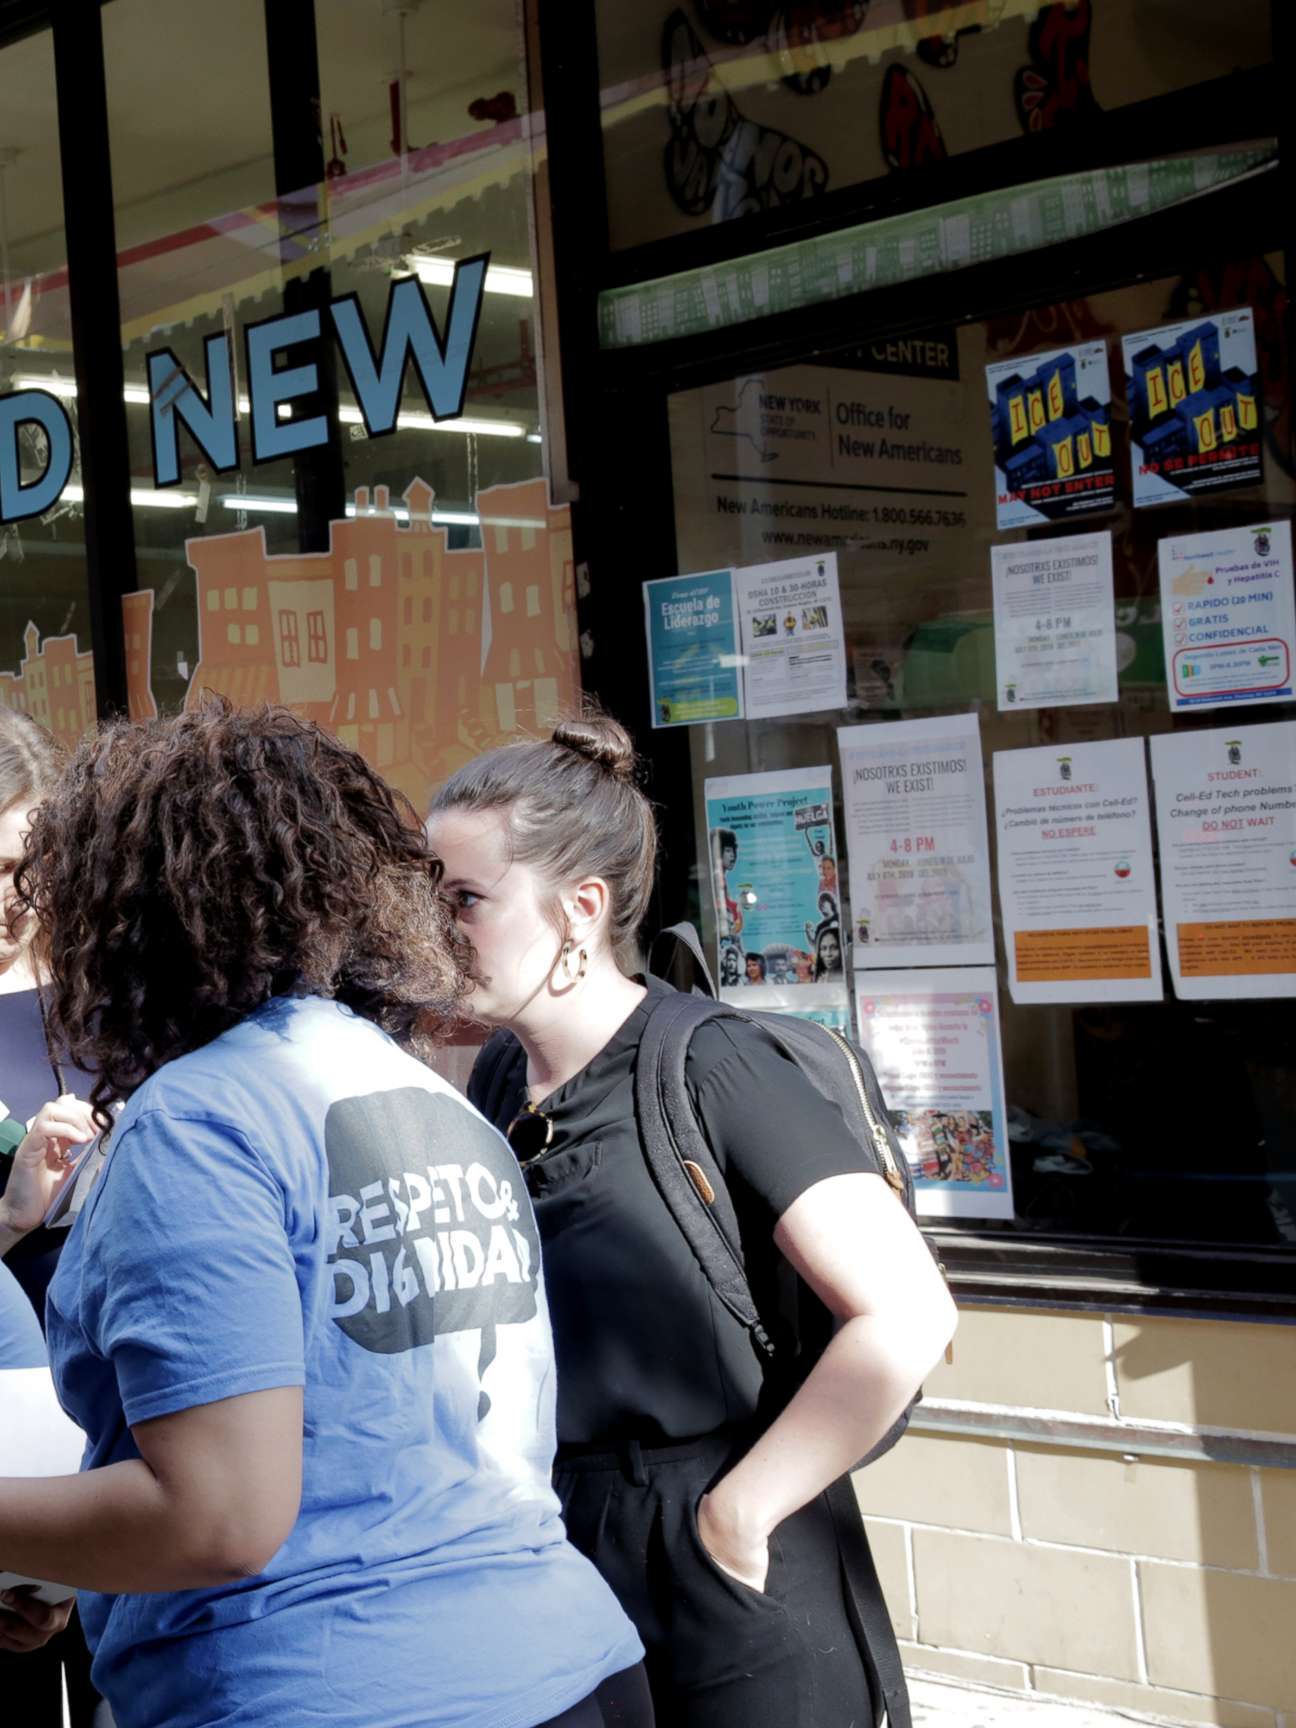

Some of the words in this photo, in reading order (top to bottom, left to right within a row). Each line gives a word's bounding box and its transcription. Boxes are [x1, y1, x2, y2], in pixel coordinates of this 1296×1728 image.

[871, 339, 950, 368] CENTER
[146, 251, 492, 488] NEW
[1149, 353, 1201, 407] ICE
[760, 394, 785, 411] NEW
[788, 398, 822, 415] YORK
[1011, 382, 1063, 433] ICE
[836, 403, 884, 427] Office
[888, 406, 911, 430] for
[1199, 400, 1254, 448] OUT
[838, 435, 874, 458] New
[878, 439, 963, 465] Americans
[1058, 427, 1106, 473] OUT
[1139, 462, 1161, 475] NO
[1164, 456, 1185, 471] SE
[1030, 480, 1062, 499] NOT
[1065, 474, 1116, 494] ENTER
[717, 497, 746, 514] New
[750, 499, 817, 519] Americans
[820, 503, 867, 522] Hotline:
[1264, 559, 1281, 568] VIH
[661, 598, 704, 617] Escuela
[706, 595, 721, 609] de
[1188, 614, 1229, 627] GRATIS
[1188, 625, 1269, 642] CONFIDENCIAL
[911, 758, 967, 778] EXISTIMOS!
[886, 781, 902, 795] WE
[904, 777, 935, 793] EXIST!
[1176, 790, 1213, 802] Cell-Ed
[1215, 788, 1241, 799] Tech
[1243, 784, 1293, 797] problems
[721, 800, 747, 813] Youth
[1170, 808, 1208, 819] Change
[1211, 804, 1222, 814] of
[1224, 803, 1257, 815] phone
[1202, 820, 1218, 832] DO
[1221, 818, 1244, 831] NOT
[1247, 815, 1275, 827] WAIT
[890, 838, 913, 853] 4-8
[916, 836, 936, 851] PM
[1041, 830, 1055, 840] NO
